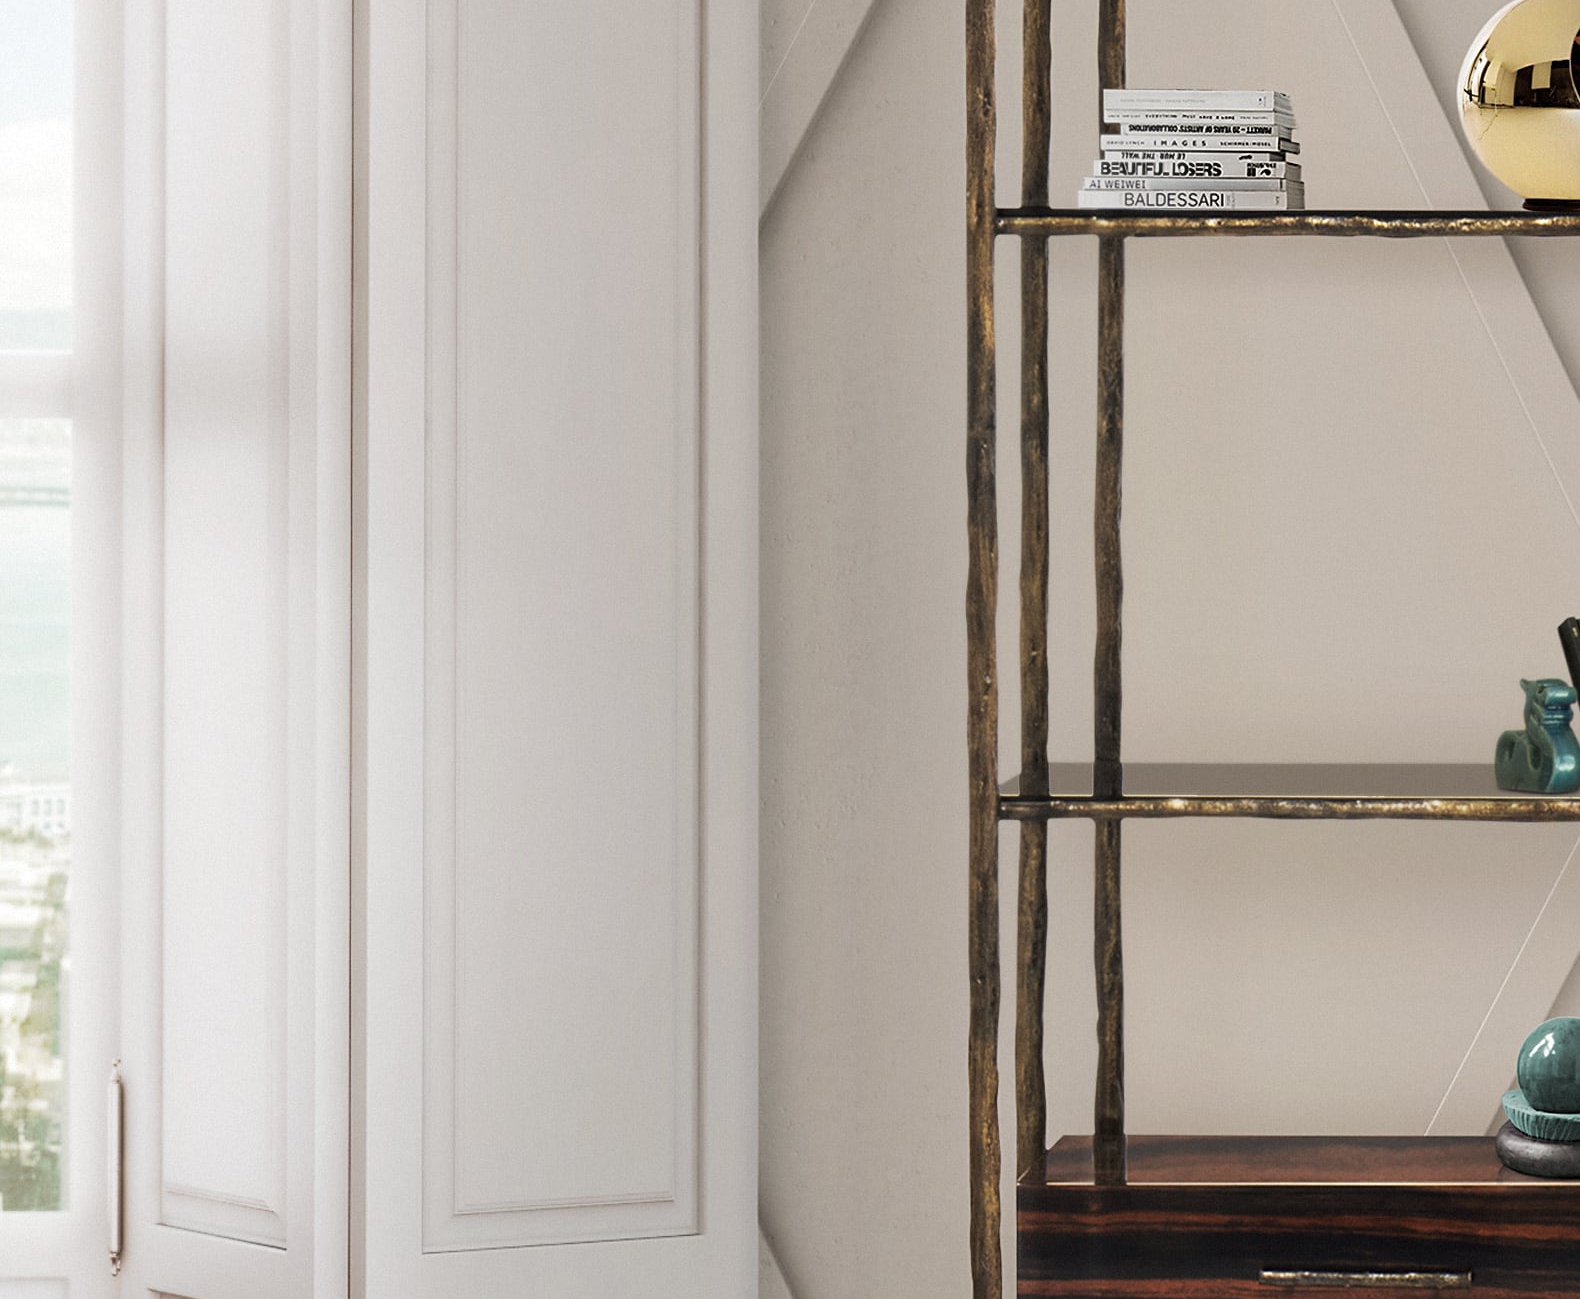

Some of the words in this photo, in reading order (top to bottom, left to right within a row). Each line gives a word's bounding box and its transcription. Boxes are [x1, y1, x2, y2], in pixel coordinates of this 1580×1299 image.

[1101, 162, 1170, 176] BEAUTIFUL
[1172, 162, 1222, 176] LOSERS
[1089, 180, 1101, 188] AI
[1105, 180, 1146, 189] WEIWEI
[1124, 193, 1225, 207] BALDESSARI
